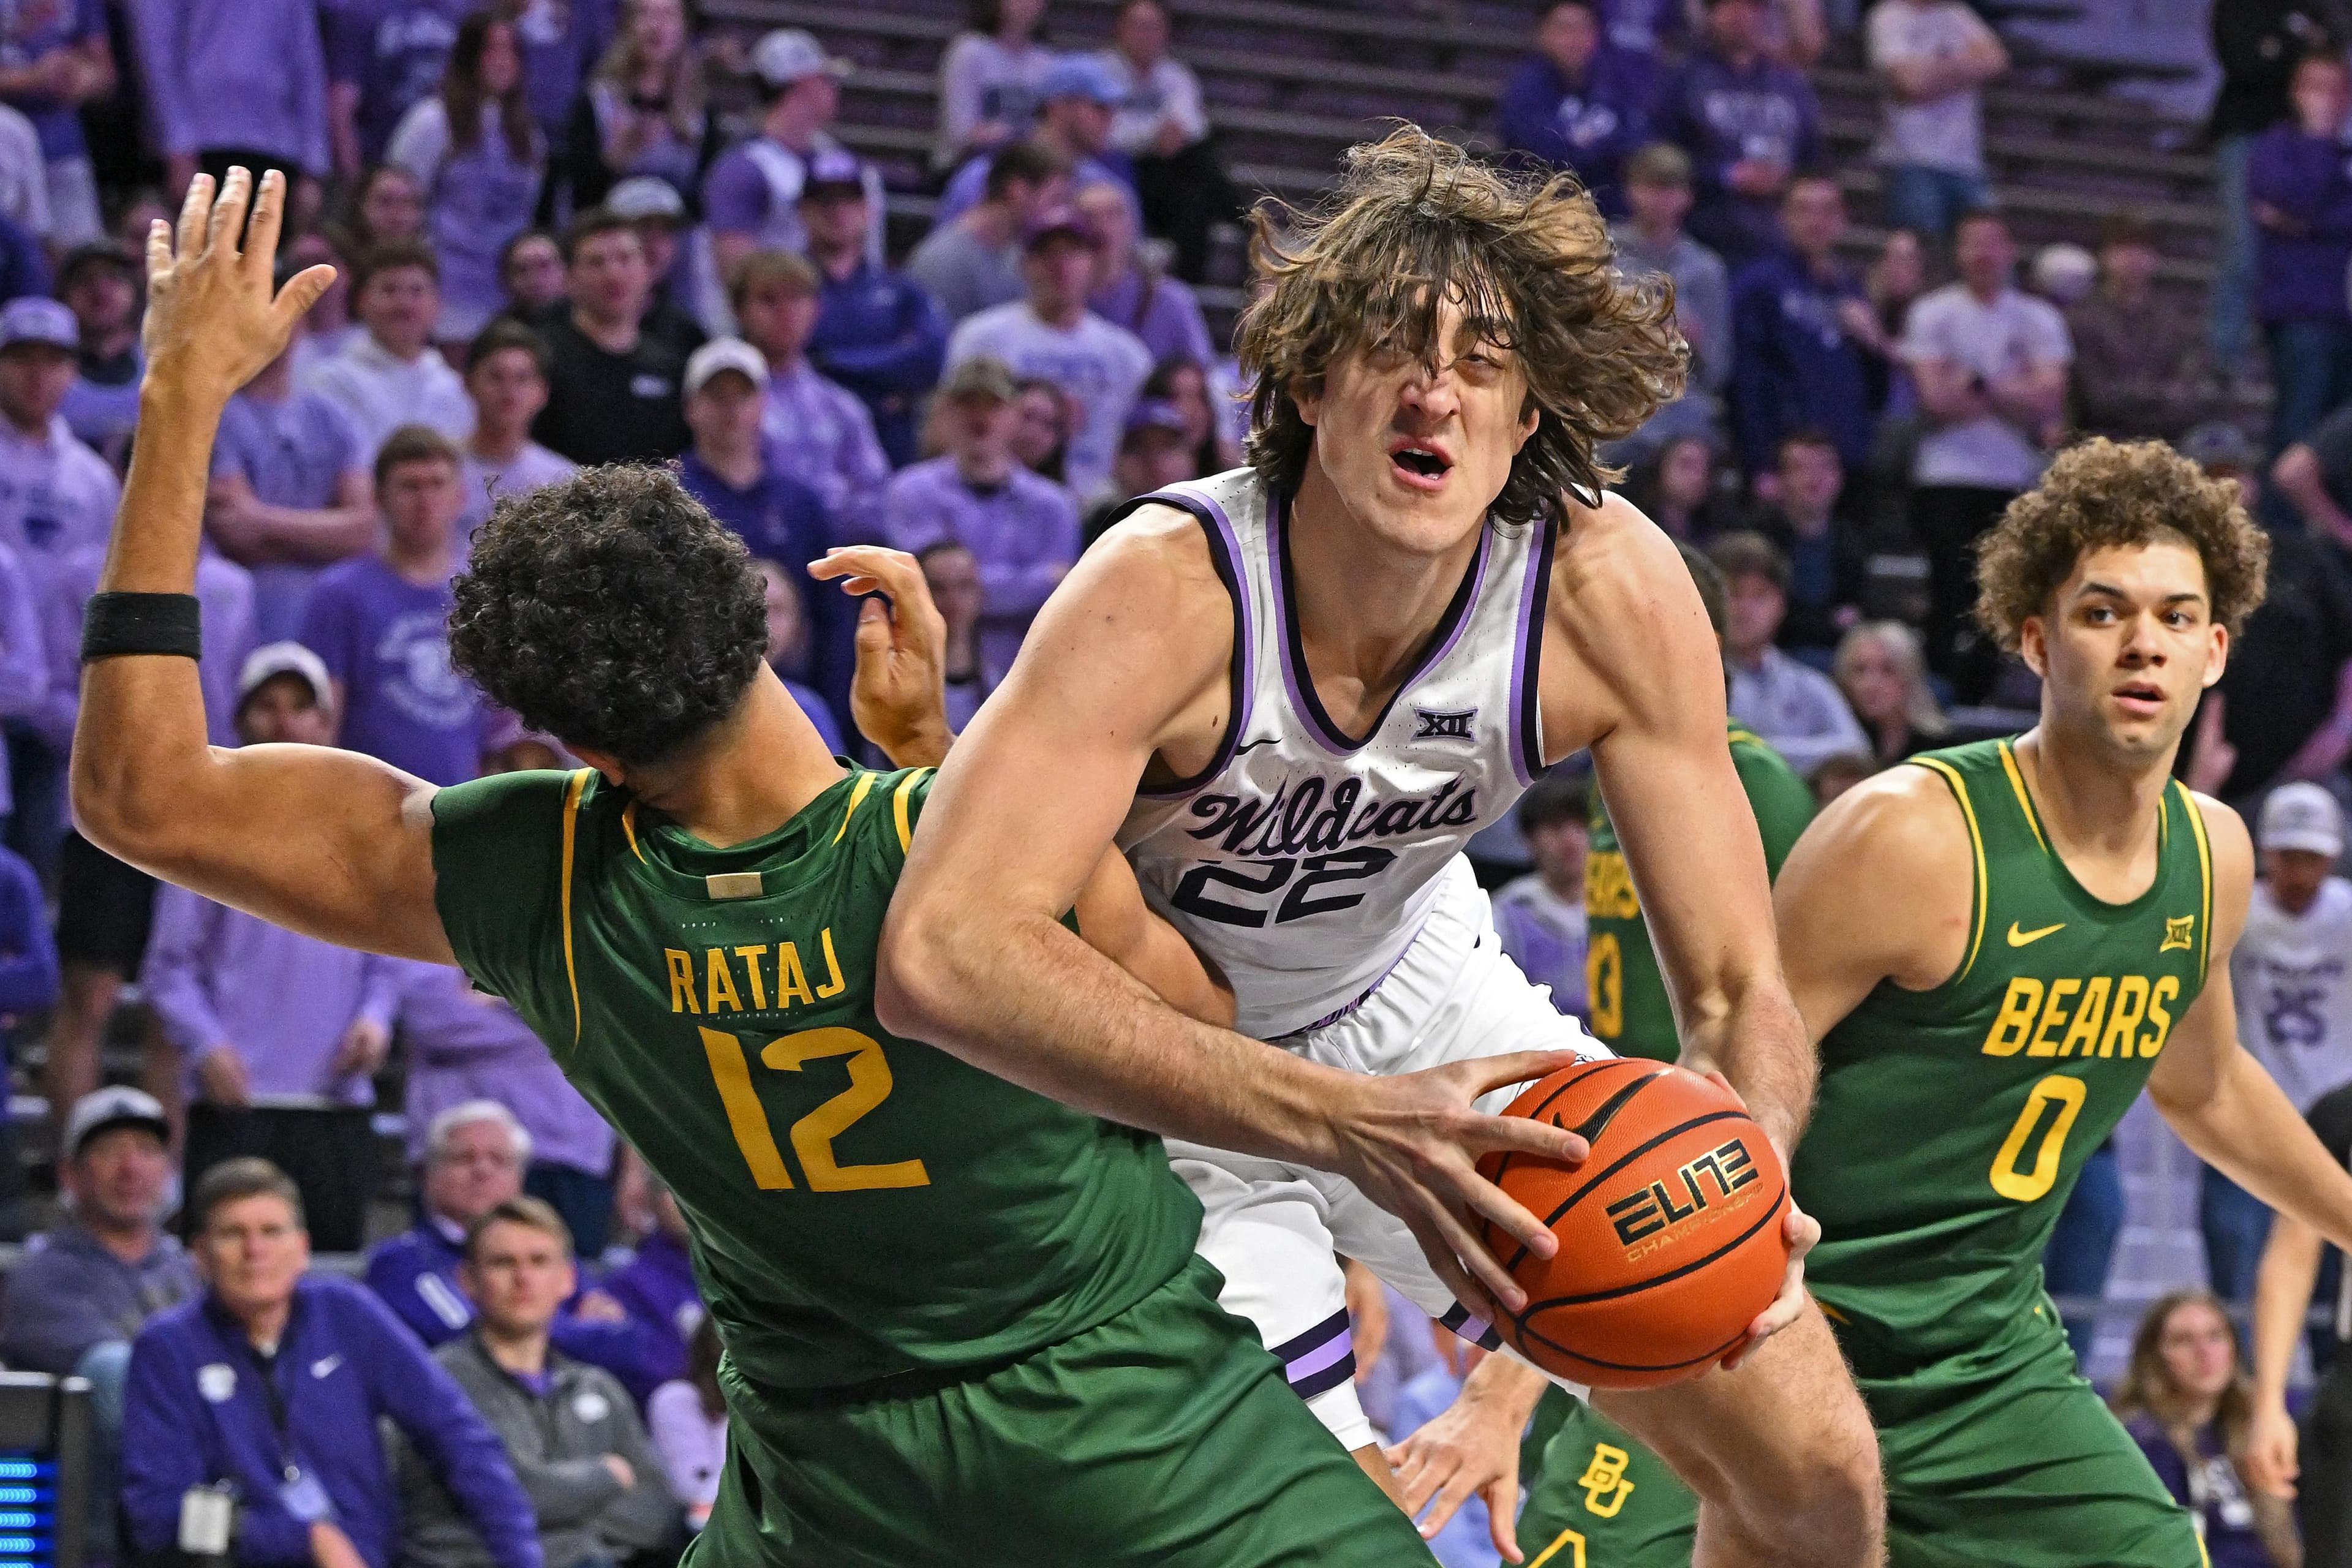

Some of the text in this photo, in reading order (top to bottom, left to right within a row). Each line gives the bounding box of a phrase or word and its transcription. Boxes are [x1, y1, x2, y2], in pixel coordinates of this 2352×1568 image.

[1412, 707, 1477, 741] XII
[1185, 770, 1478, 857] Wildcats
[1170, 846, 1398, 928] 22
[665, 927, 845, 1014] RATAJ
[1981, 975, 2180, 1058] BEARS
[698, 1025, 931, 1193] 12
[1989, 1074, 2087, 1202] 0
[1605, 1137, 1760, 1247] ELITE
[1578, 1442, 1635, 1518] BU
